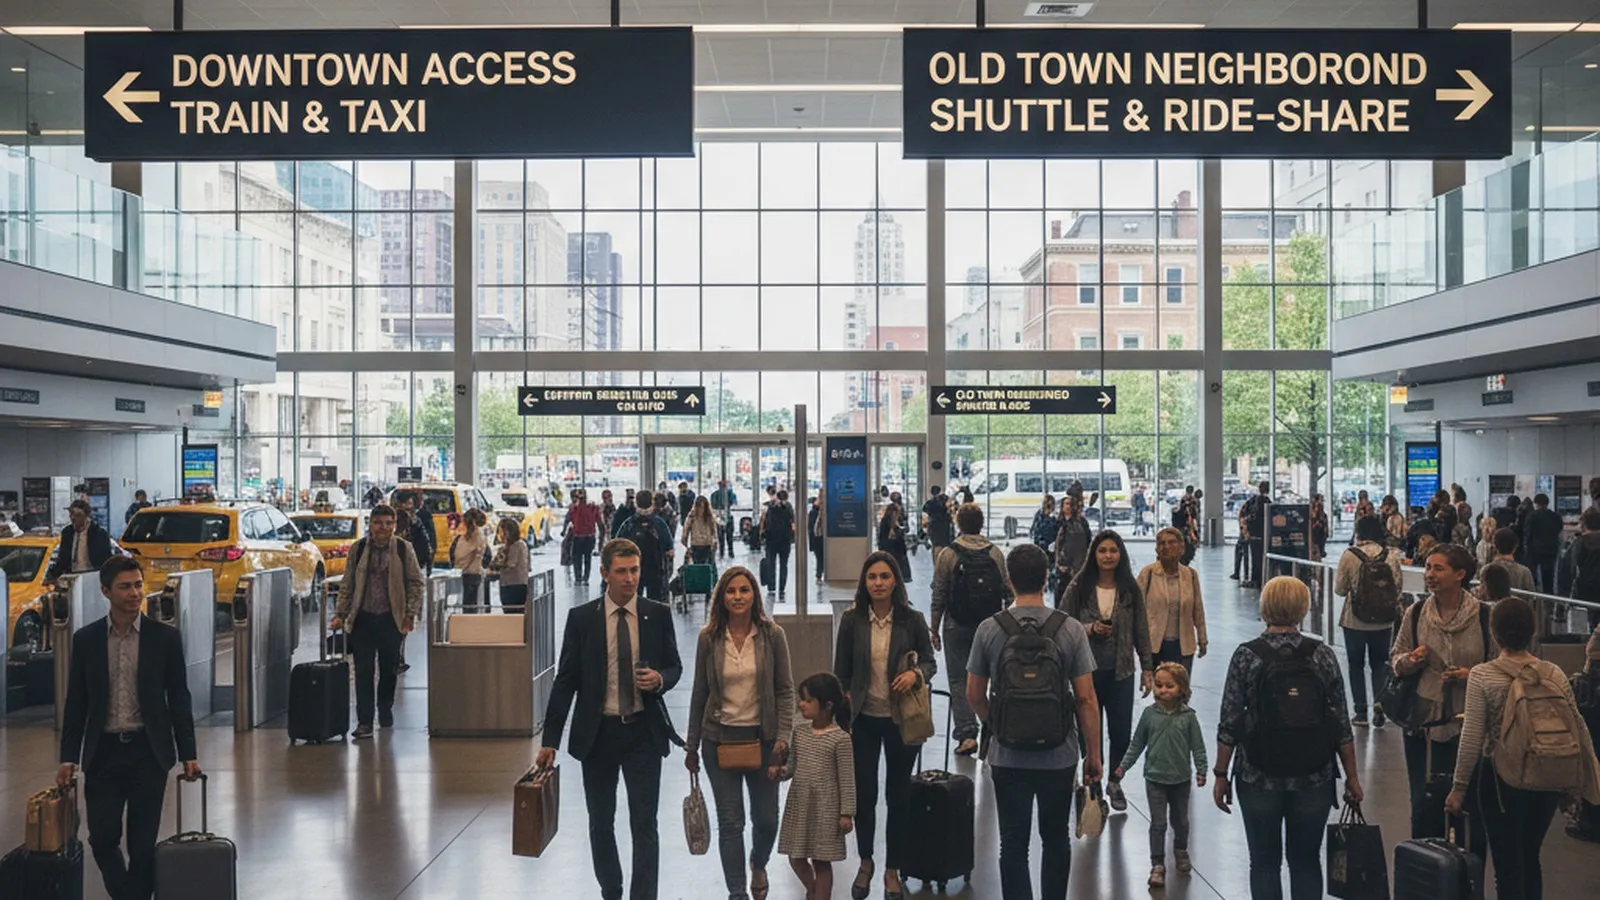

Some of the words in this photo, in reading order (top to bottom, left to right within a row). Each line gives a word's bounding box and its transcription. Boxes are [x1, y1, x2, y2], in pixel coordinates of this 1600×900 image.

[173, 53, 408, 87] DOWNTOWN
[422, 51, 577, 85] ACCESS
[930, 52, 1006, 85] OLD
[1017, 53, 1131, 84] TOWN
[1145, 52, 1427, 85] NEIGHBOROND
[171, 101, 289, 134] TRAIN
[303, 100, 330, 133] &
[340, 99, 426, 133] TAXI
[930, 98, 1109, 132] SHUTTLE
[1123, 98, 1151, 132] &
[1164, 98, 1410, 132] RIDE-SHARE
